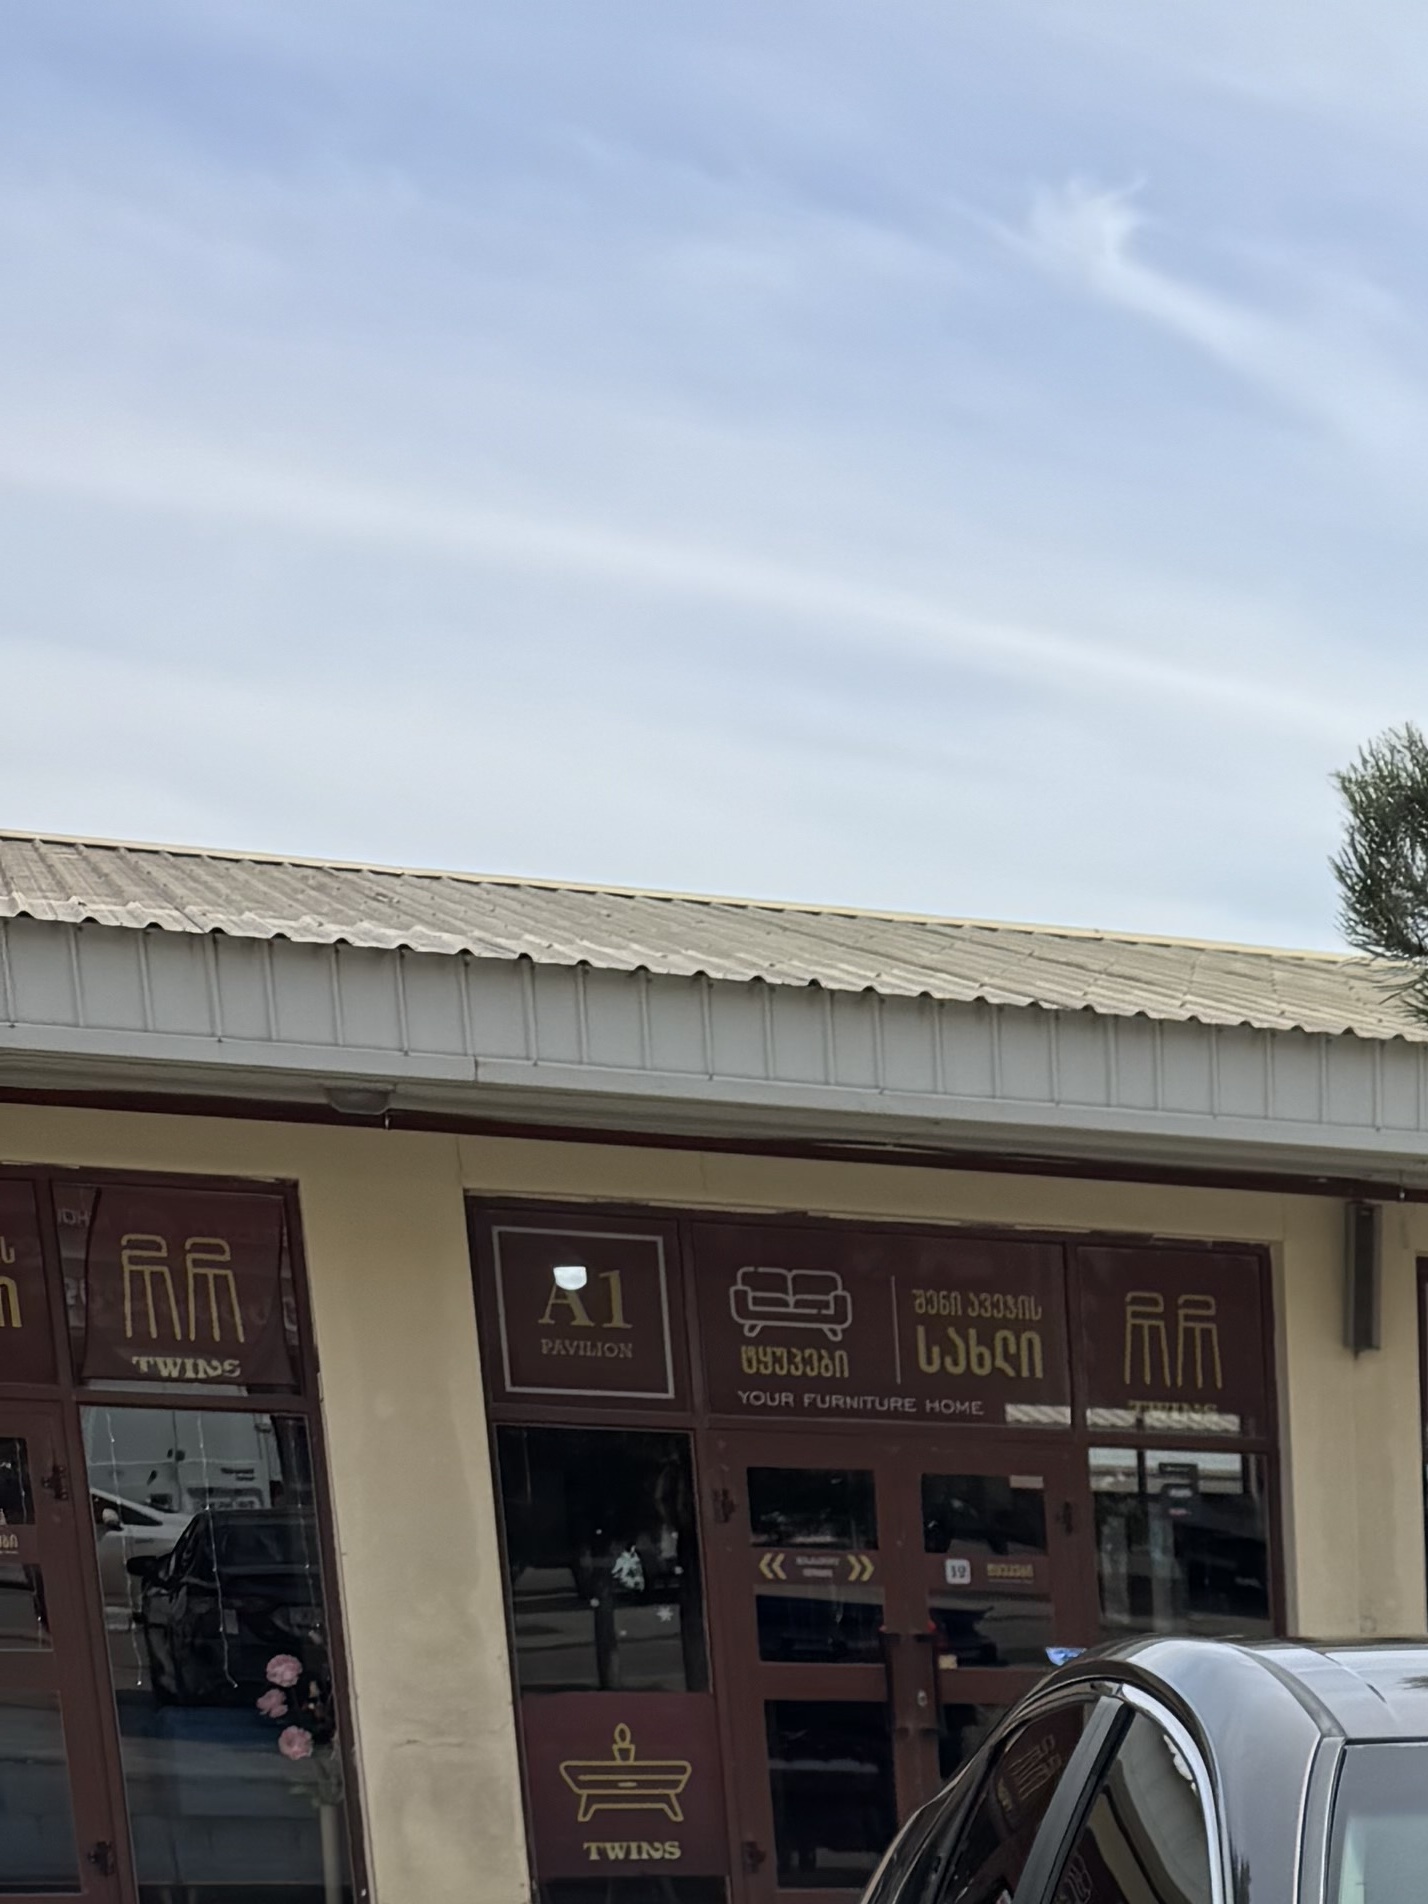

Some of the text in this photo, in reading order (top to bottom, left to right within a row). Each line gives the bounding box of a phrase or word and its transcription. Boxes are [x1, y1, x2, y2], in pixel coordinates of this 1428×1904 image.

[537, 1265, 634, 1329] A1
[911, 1288, 1043, 1322] შენი ავეჯის
[540, 1338, 634, 1359] PAVILION
[740, 1343, 850, 1379] ტყუპები
[915, 1323, 1045, 1380] სახლი
[131, 1355, 242, 1379] TWINS
[737, 1389, 985, 1417] YOUR FURNITURE HOME
[582, 1840, 683, 1861] TWINS
